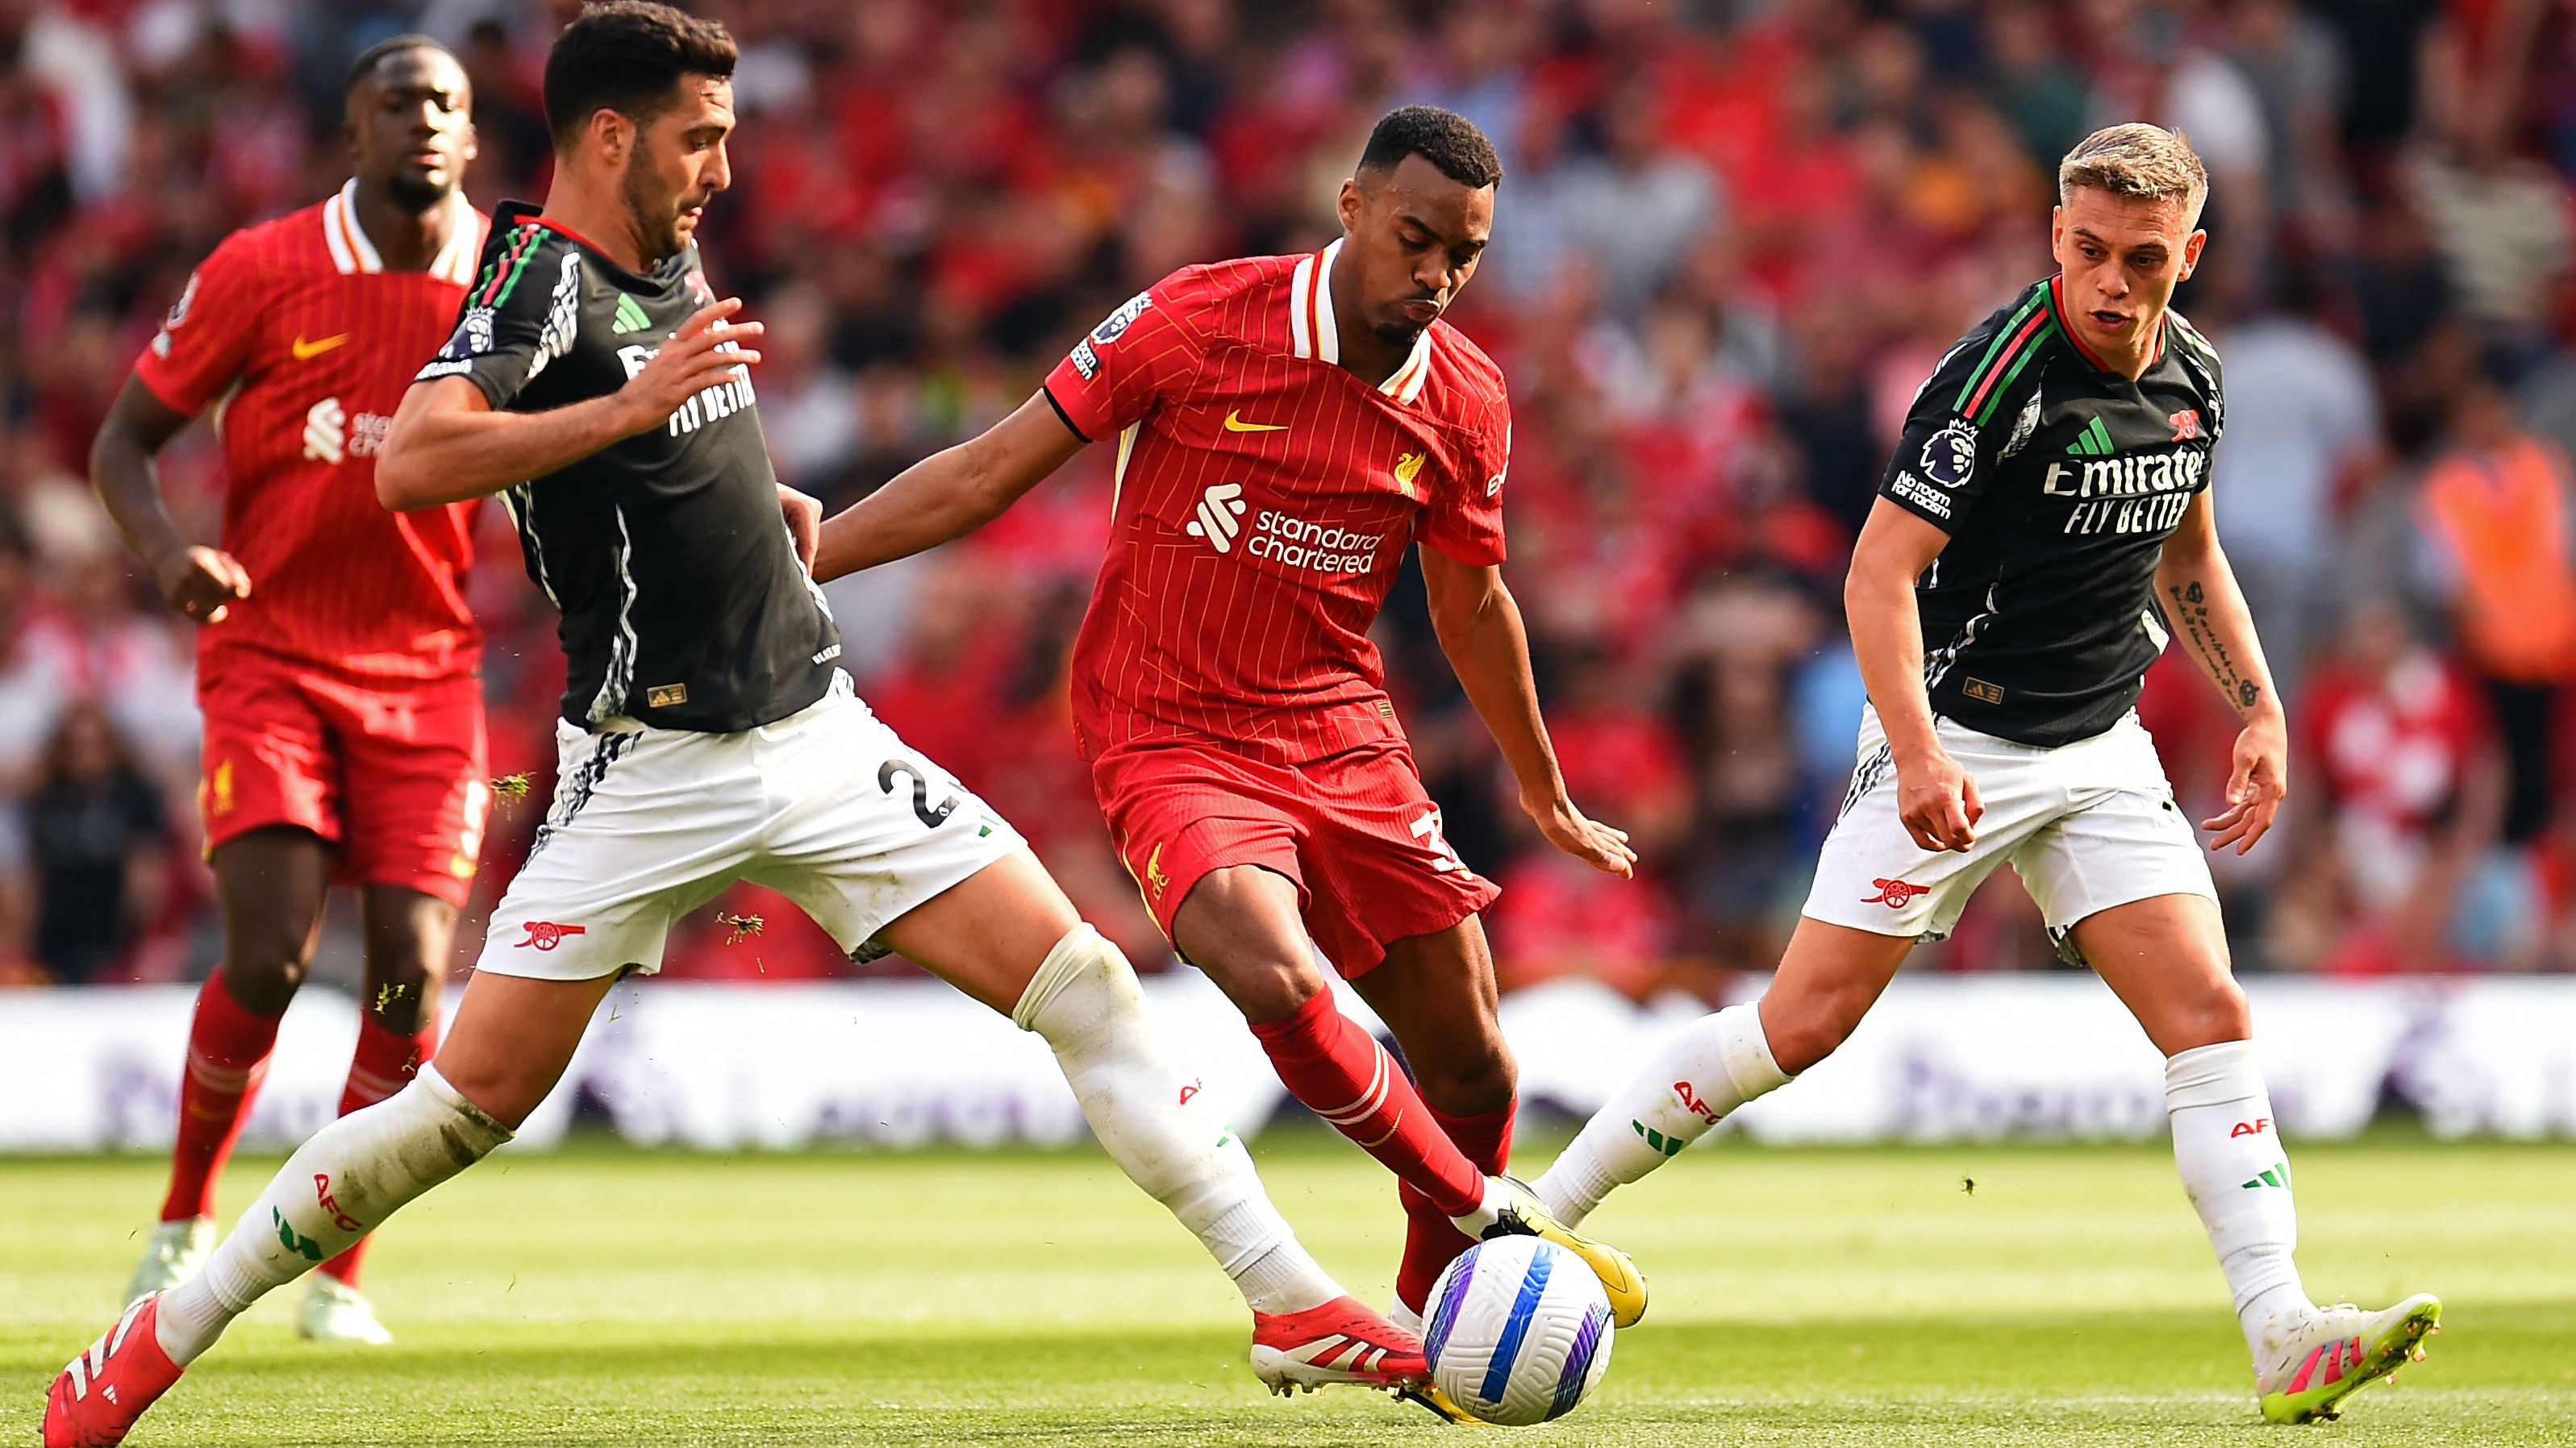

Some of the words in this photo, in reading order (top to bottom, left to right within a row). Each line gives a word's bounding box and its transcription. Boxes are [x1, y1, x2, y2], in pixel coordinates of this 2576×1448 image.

[1894, 470, 1916, 488] No
[1915, 482, 1951, 507] room
[1256, 510, 1386, 551] standard
[2064, 501, 2115, 535] FLY
[1248, 535, 1376, 574] chartered
[1674, 1081, 1724, 1126] AFC
[2231, 1117, 2270, 1138] AF
[314, 1174, 361, 1232] AFC
